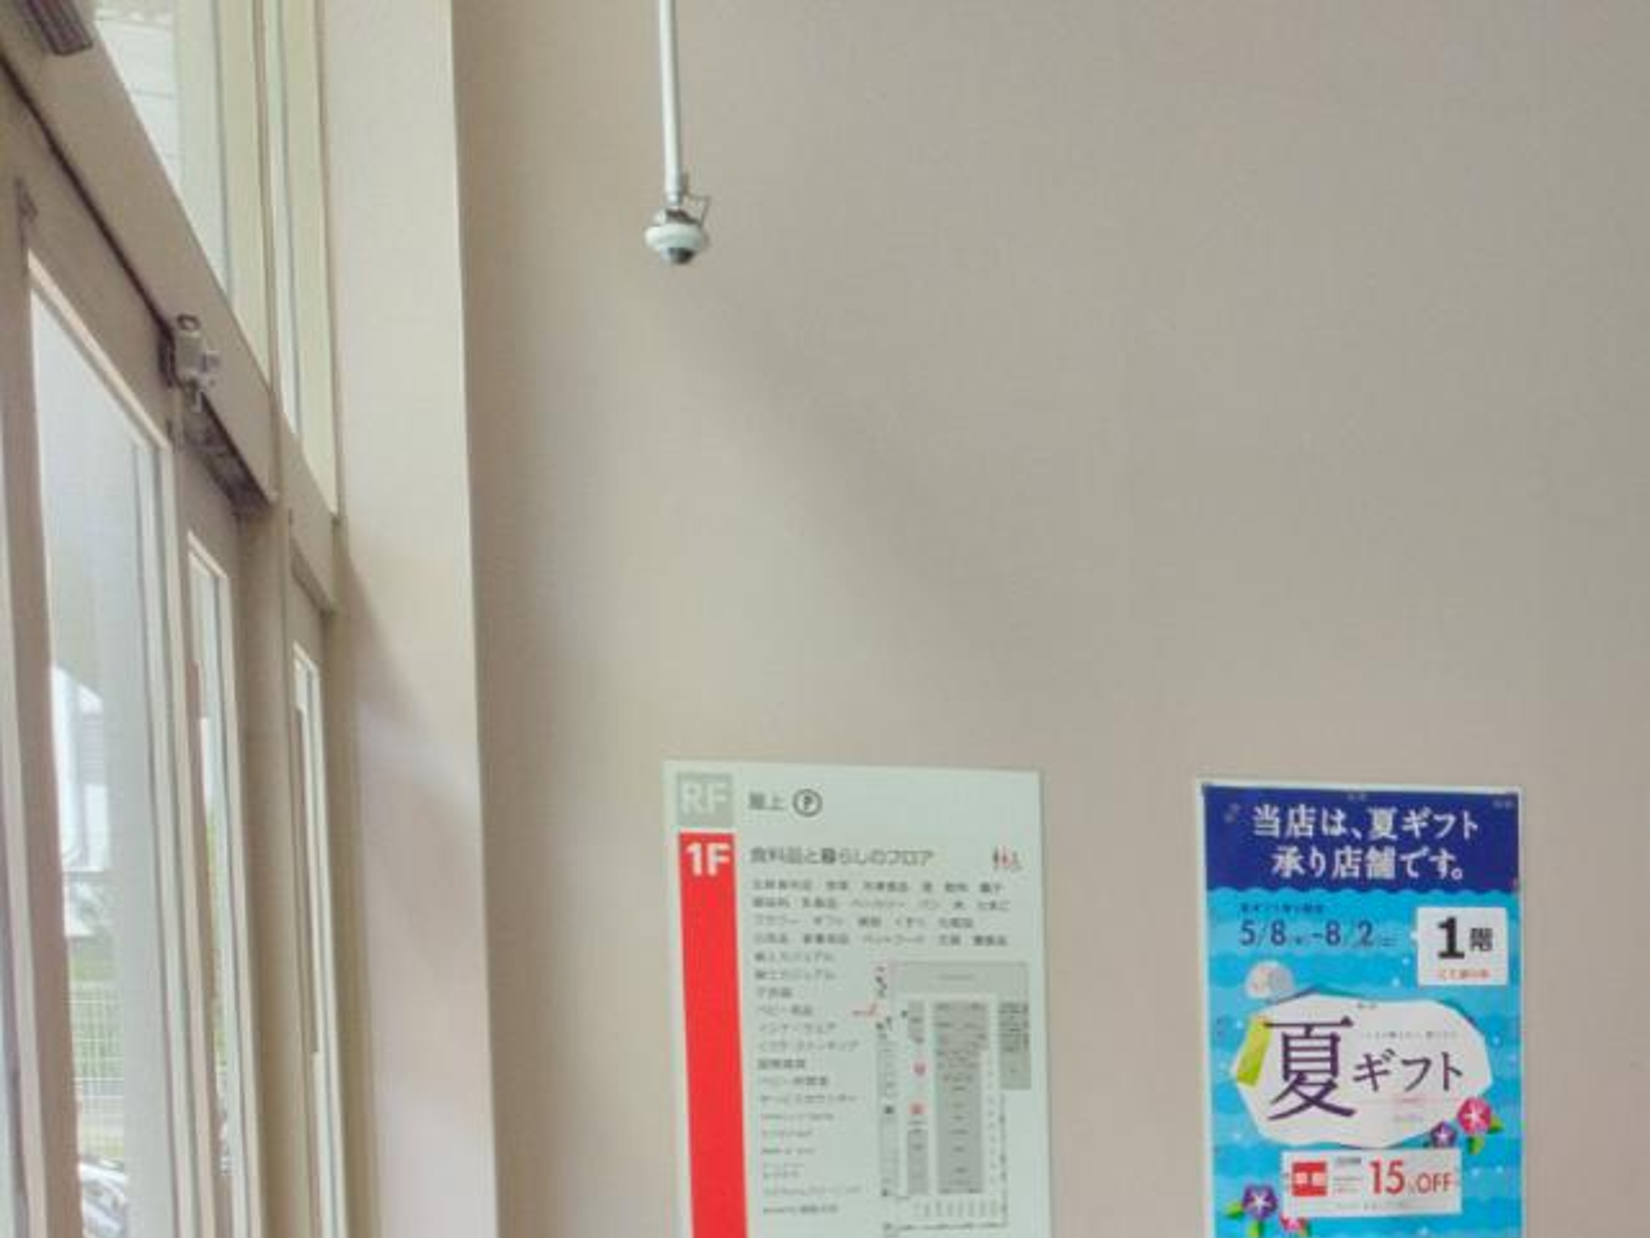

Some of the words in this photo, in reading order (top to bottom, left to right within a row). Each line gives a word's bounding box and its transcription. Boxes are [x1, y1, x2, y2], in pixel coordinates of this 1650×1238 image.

[680, 781, 728, 814] RF
[1252, 804, 1480, 840] 当店は、夏ギフト
[686, 842, 731, 877] 1F
[1271, 845, 1465, 881] 承り店舗です。
[1437, 916, 1493, 960] 1階
[1262, 1016, 1464, 1121] 夏ギフト
